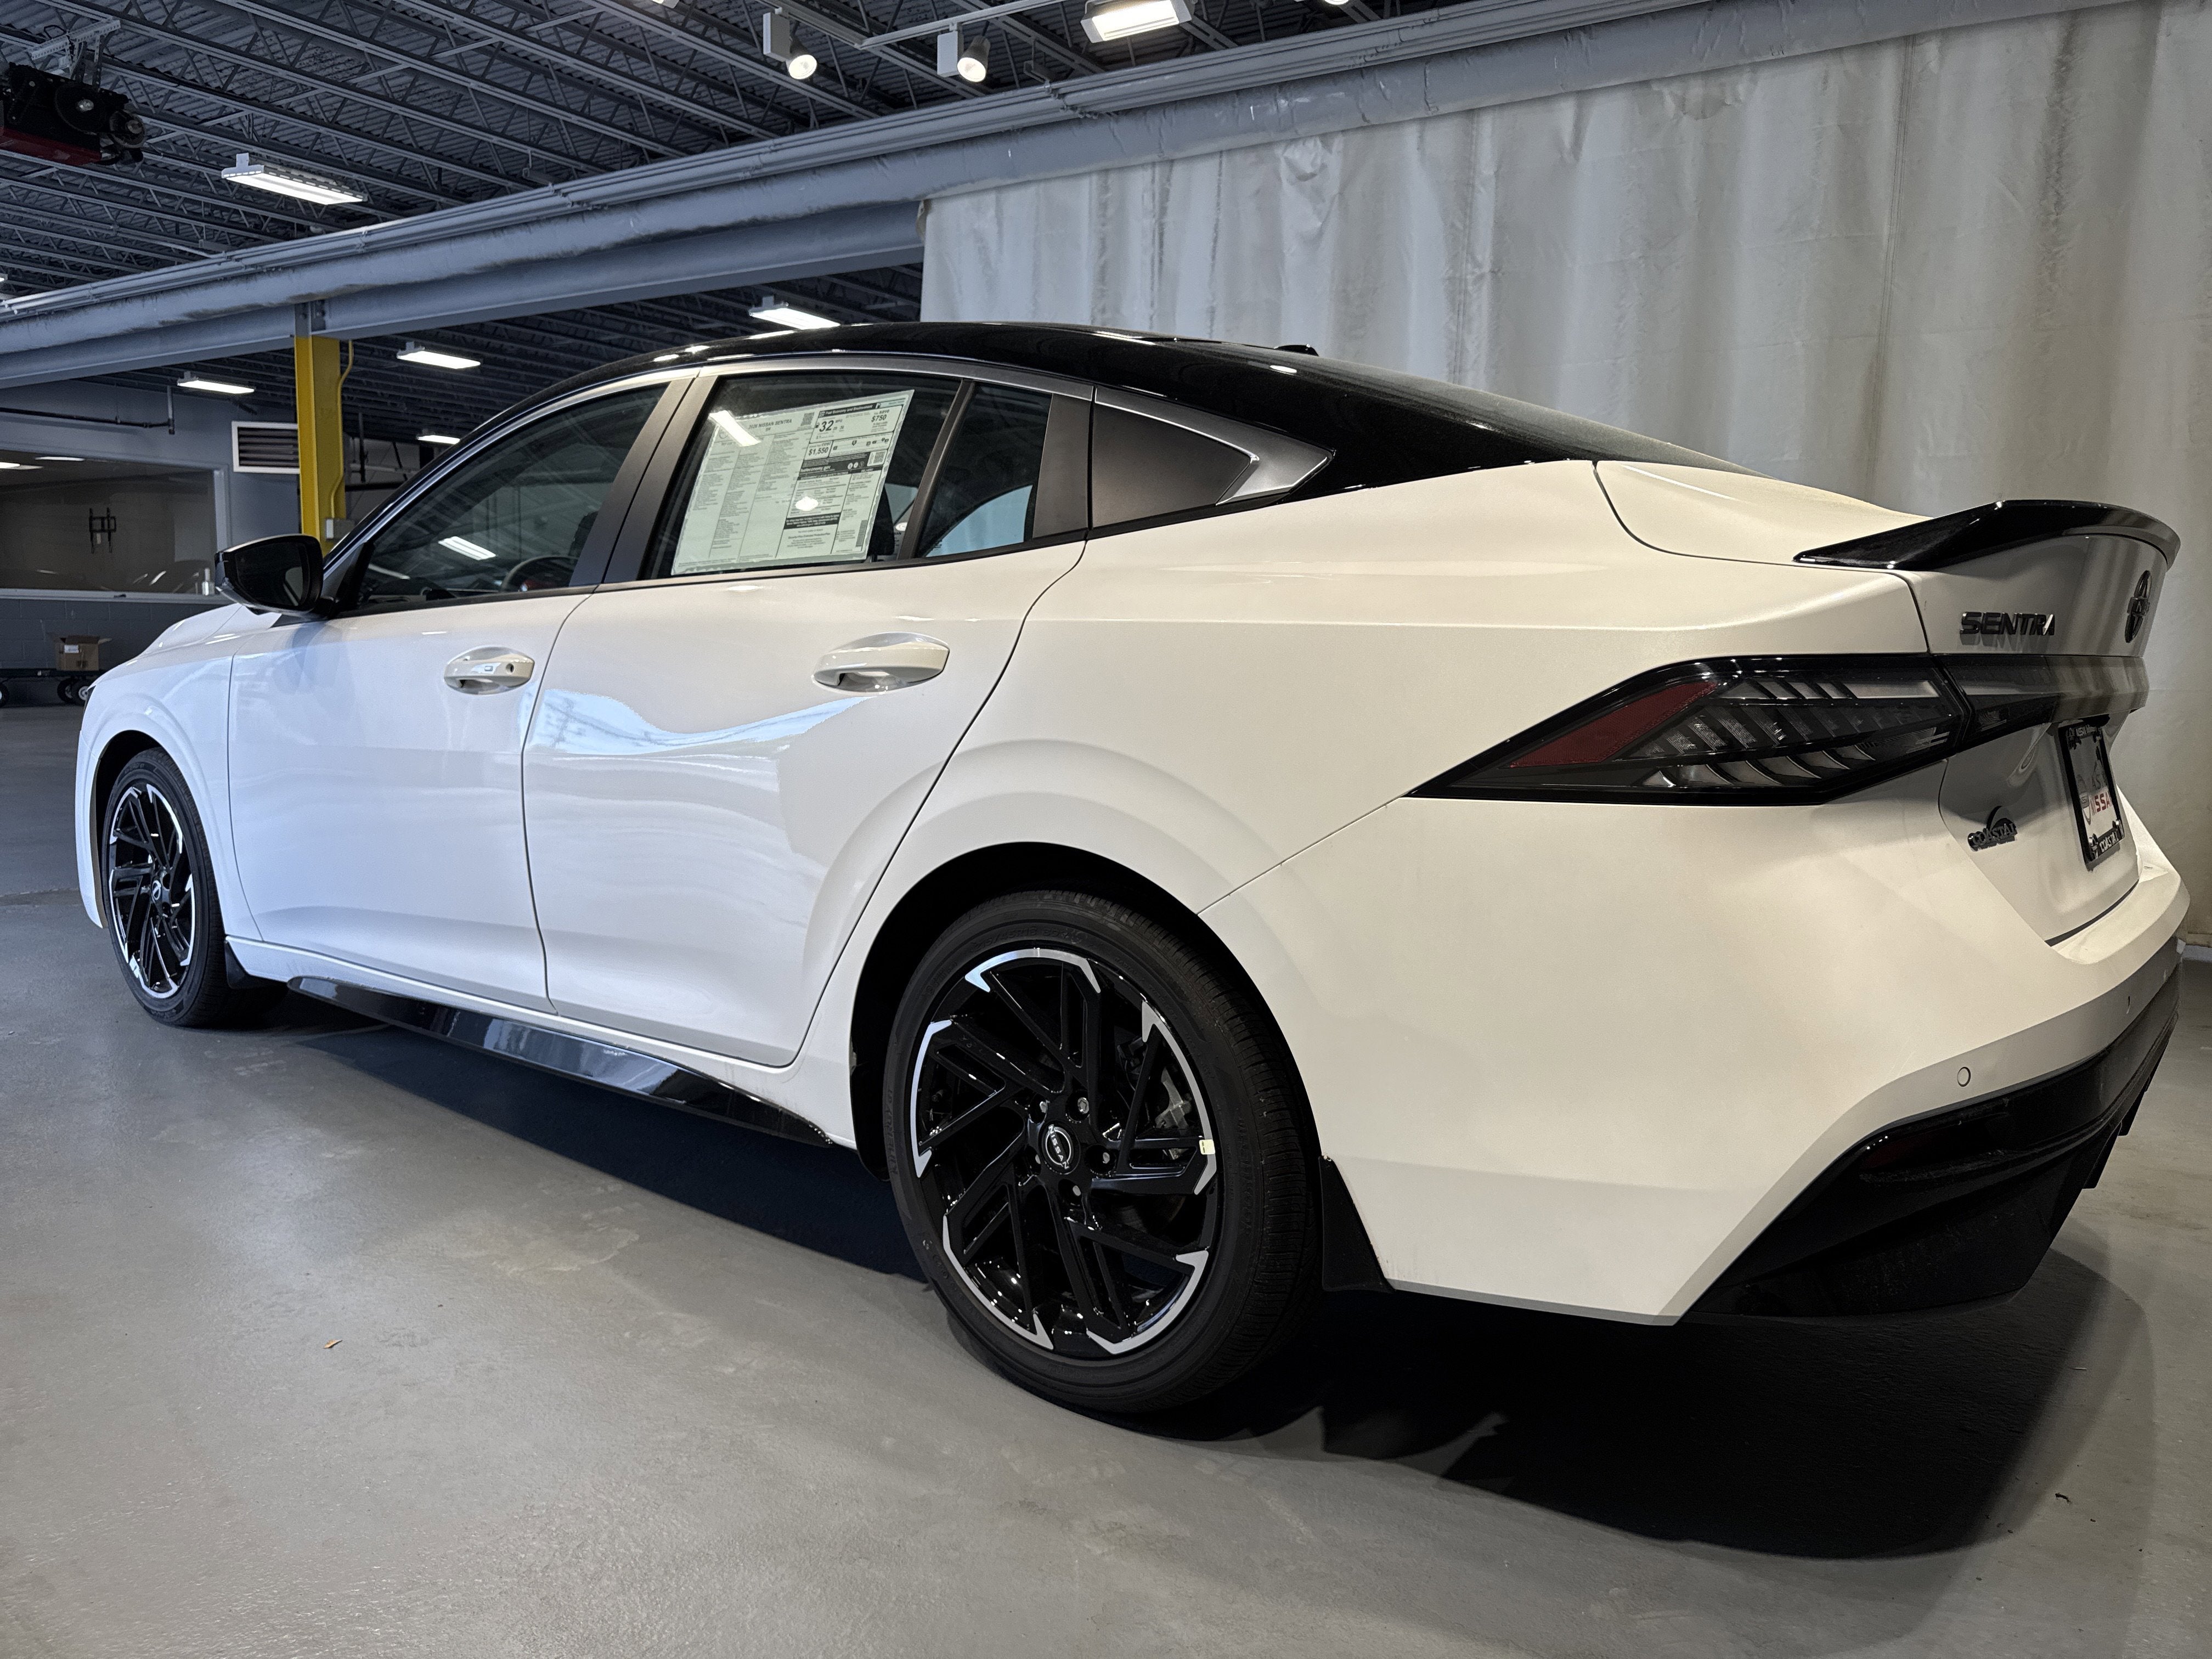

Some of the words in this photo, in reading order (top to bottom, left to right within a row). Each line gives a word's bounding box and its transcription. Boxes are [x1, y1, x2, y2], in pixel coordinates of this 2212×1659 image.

[871, 414, 887, 422] $750
[819, 420, 834, 432] 32
[808, 447, 829, 456] $1,550
[1960, 611, 2055, 636] SENTRA
[1048, 1124, 1070, 1170] NISSAN
